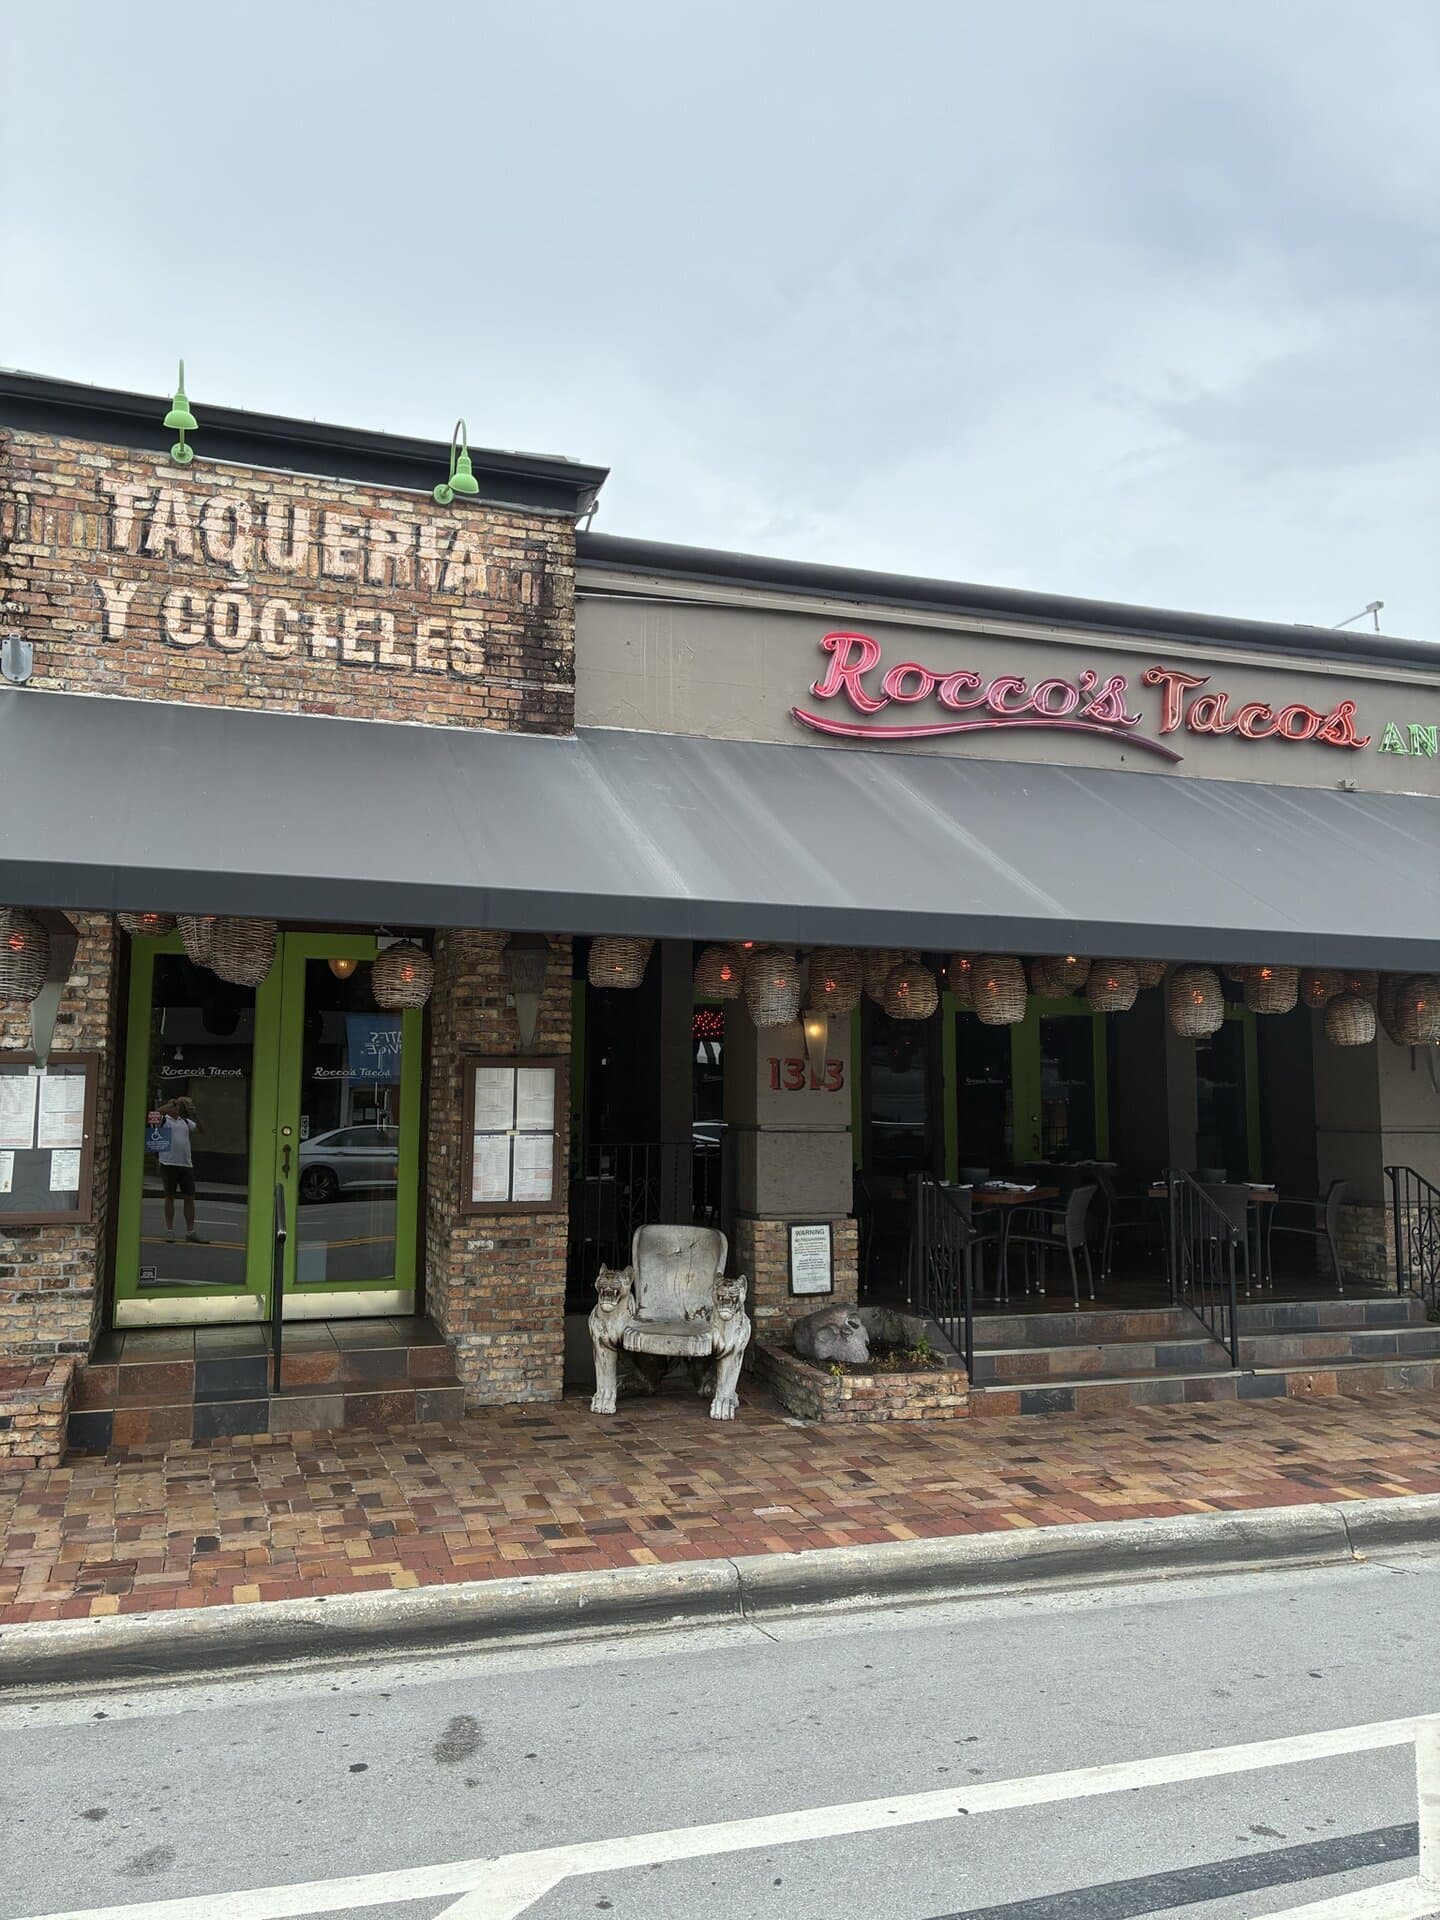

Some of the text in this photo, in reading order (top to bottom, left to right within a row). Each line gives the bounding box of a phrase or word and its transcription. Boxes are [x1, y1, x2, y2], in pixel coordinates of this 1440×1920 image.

[99, 578, 142, 643] Y
[810, 631, 1440, 759] Rocco's Tacos AN
